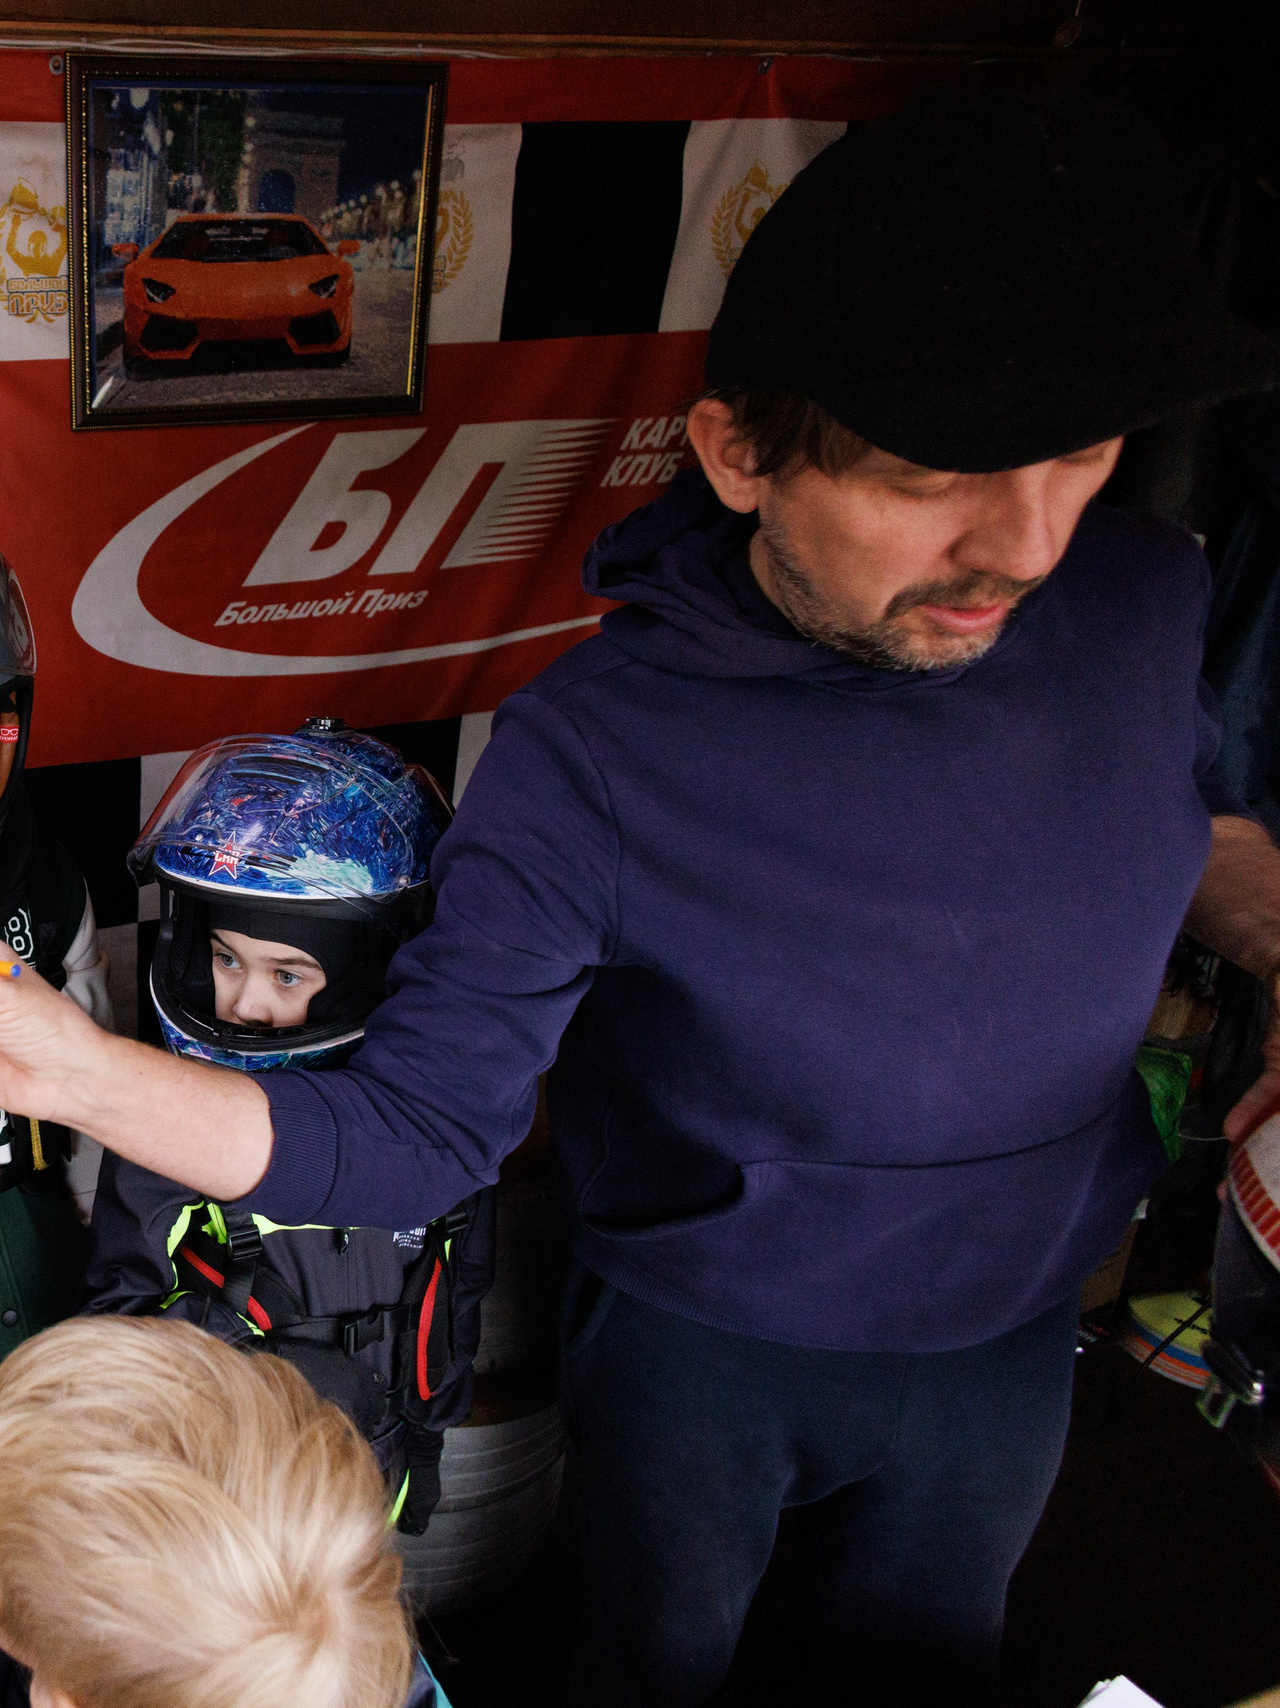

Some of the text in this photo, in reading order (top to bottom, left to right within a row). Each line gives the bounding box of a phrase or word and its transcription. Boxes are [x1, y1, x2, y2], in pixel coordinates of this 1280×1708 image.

[620, 415, 688, 451] КАР
[600, 452, 684, 487] КЛУБ
[241, 418, 619, 588] БП
[213, 588, 429, 627] Большой Приз
